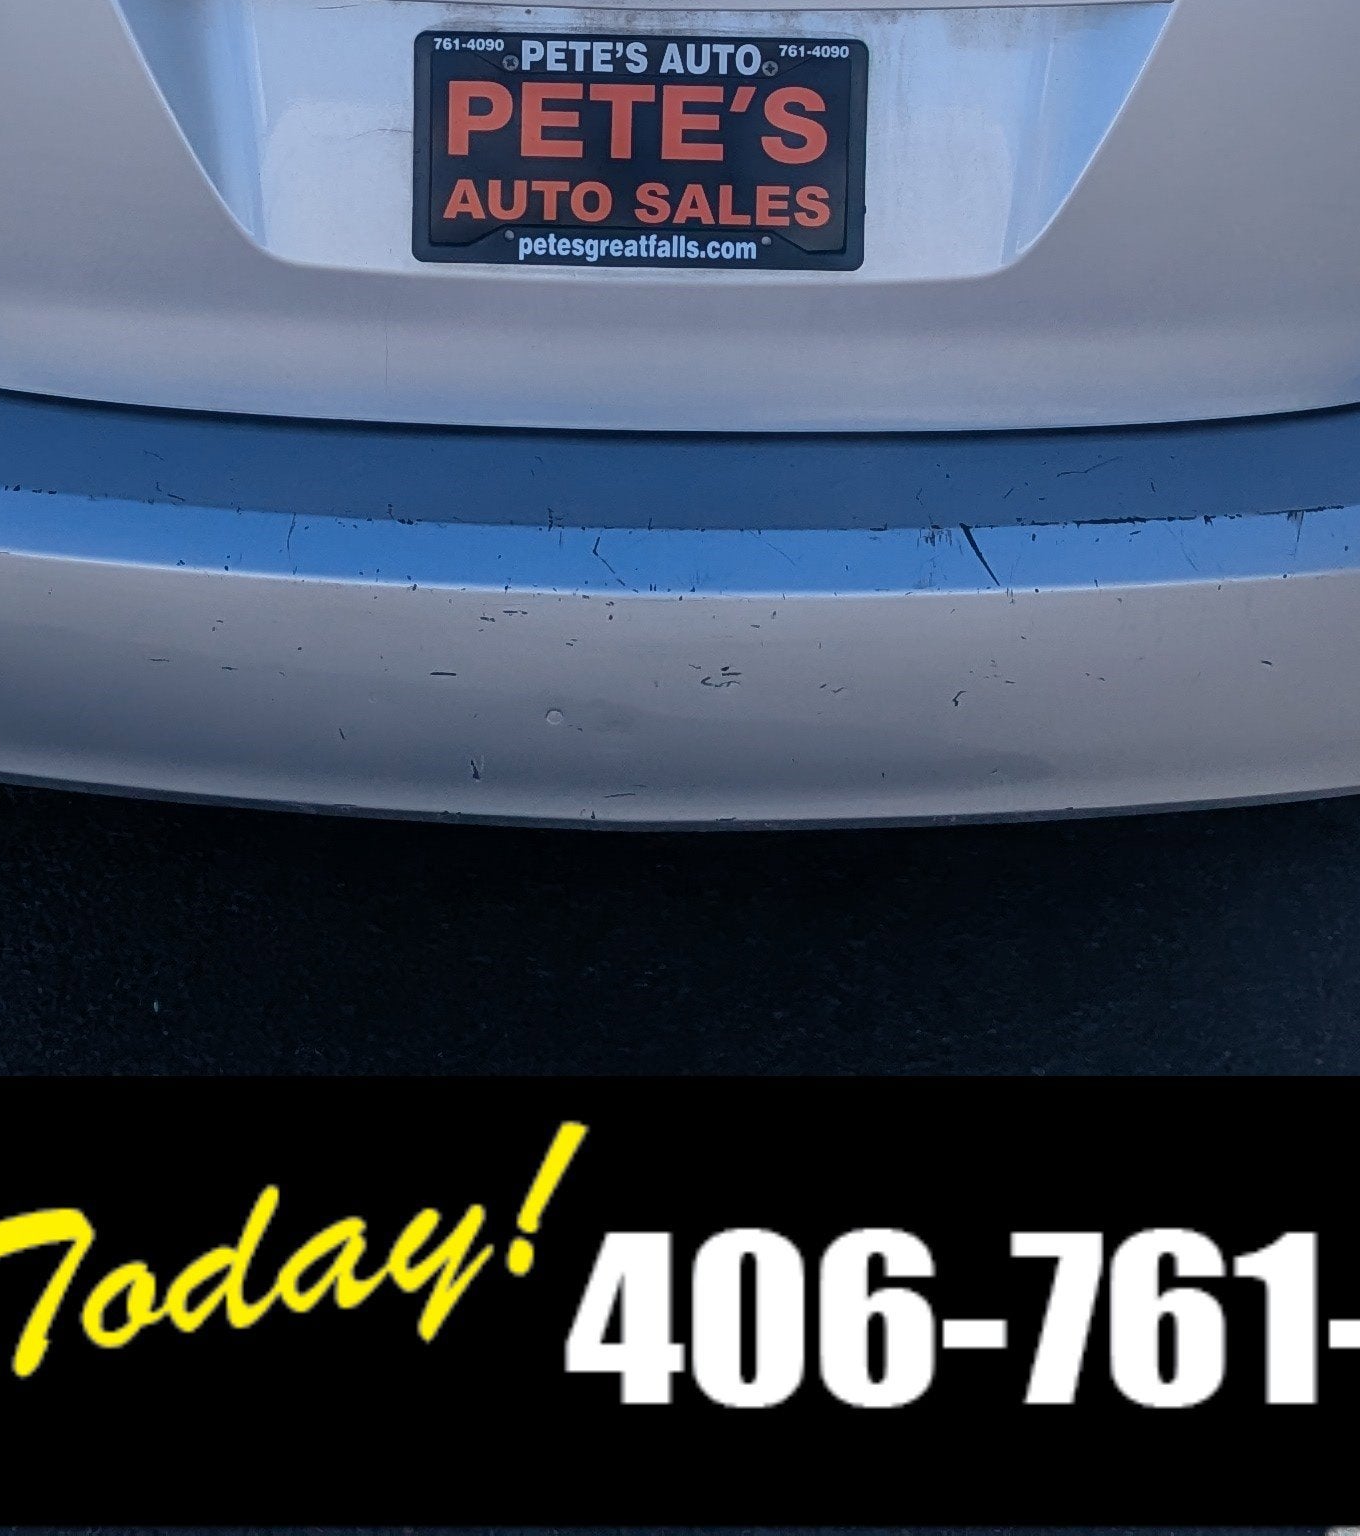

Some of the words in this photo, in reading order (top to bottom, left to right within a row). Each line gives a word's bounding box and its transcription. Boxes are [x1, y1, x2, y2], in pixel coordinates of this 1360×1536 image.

[433, 37, 505, 53] 761-4090
[521, 40, 648, 73] PETE'S
[660, 43, 762, 76] AUTO
[778, 44, 850, 59] 761-4090
[447, 80, 829, 164] PETE'S
[443, 179, 613, 223] AUTO
[634, 182, 831, 227] SALES
[518, 233, 757, 262] petesgreatfalls.com
